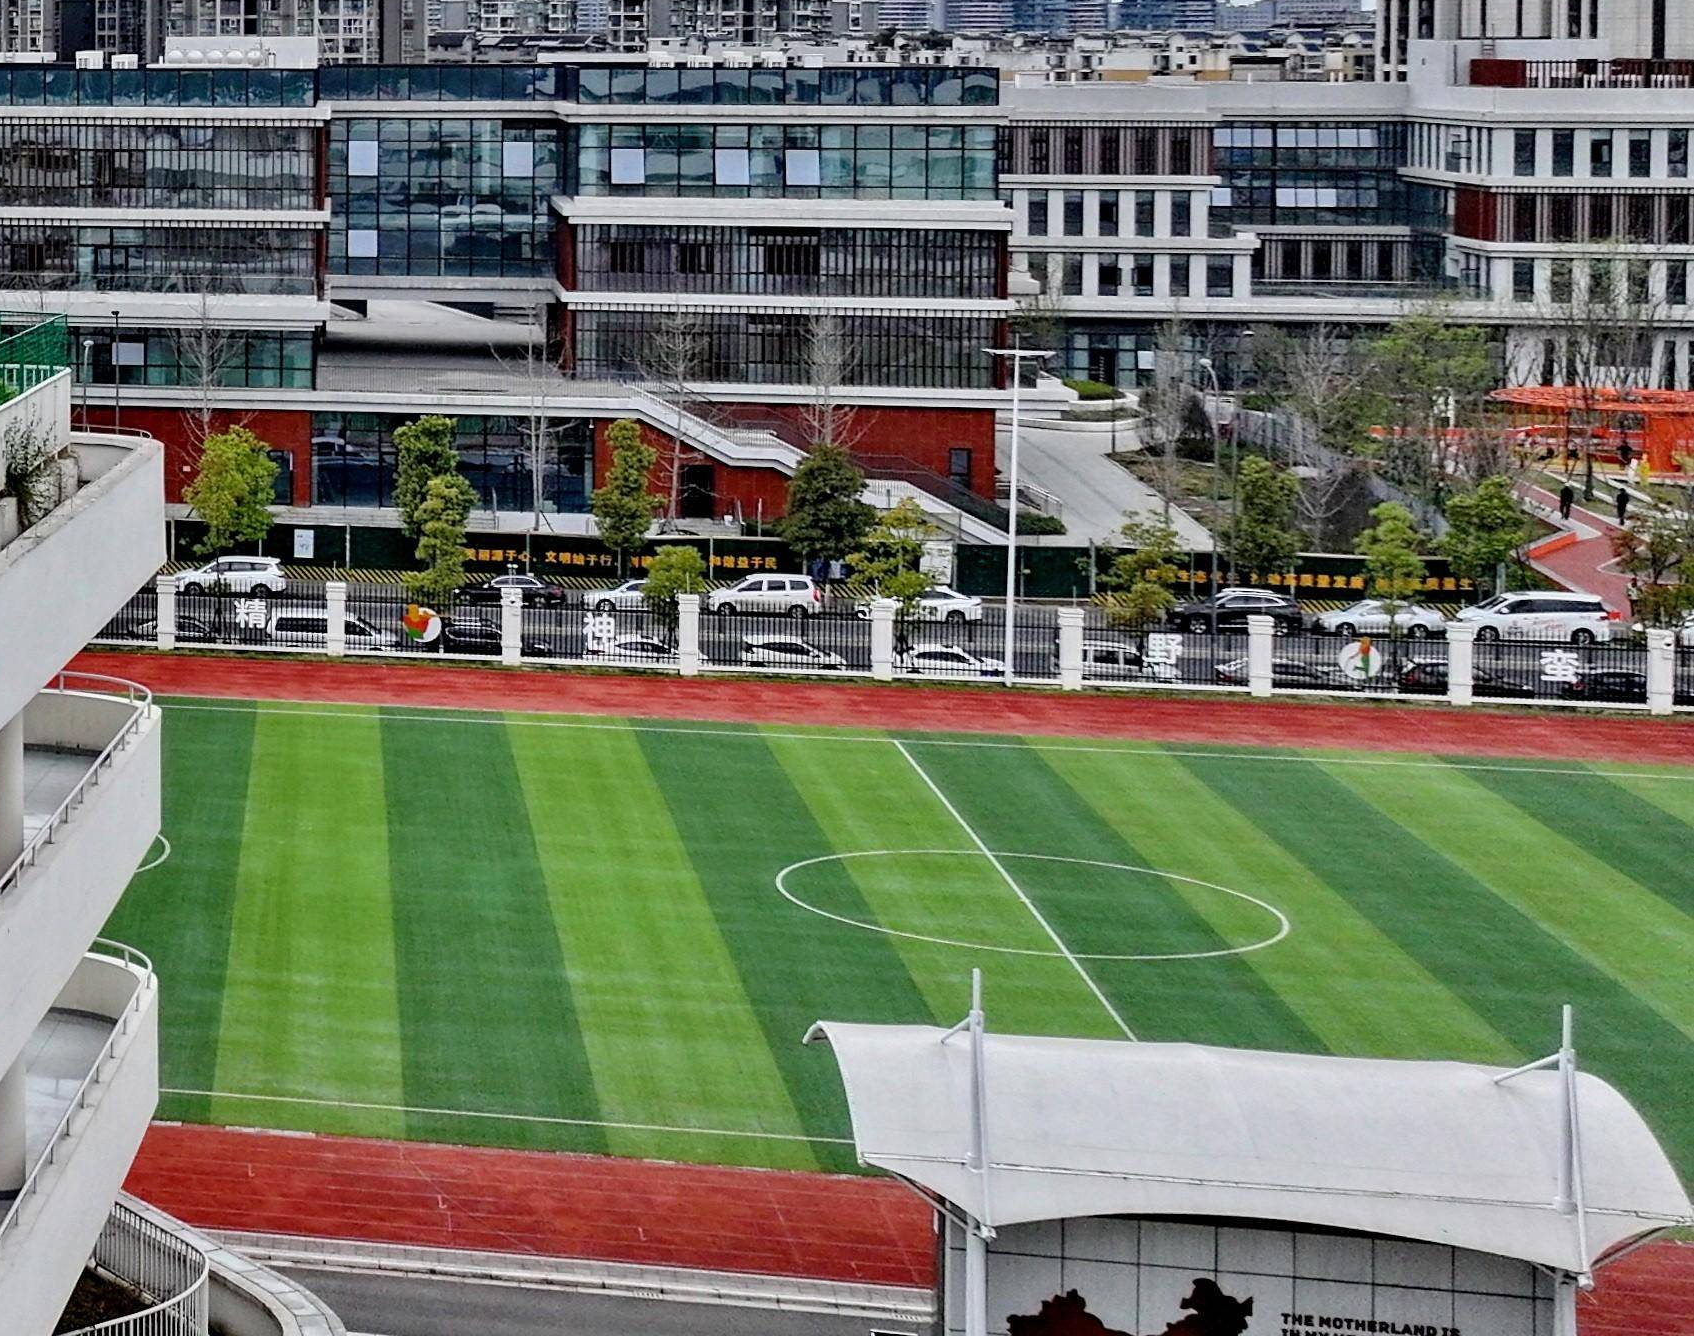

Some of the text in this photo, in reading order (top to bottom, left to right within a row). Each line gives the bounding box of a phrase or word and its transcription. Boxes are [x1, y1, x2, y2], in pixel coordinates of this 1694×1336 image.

[233, 598, 1580, 684] 精 神 野 蛮
[1281, 1313, 1461, 1336] THE MOTHERLAND IS
